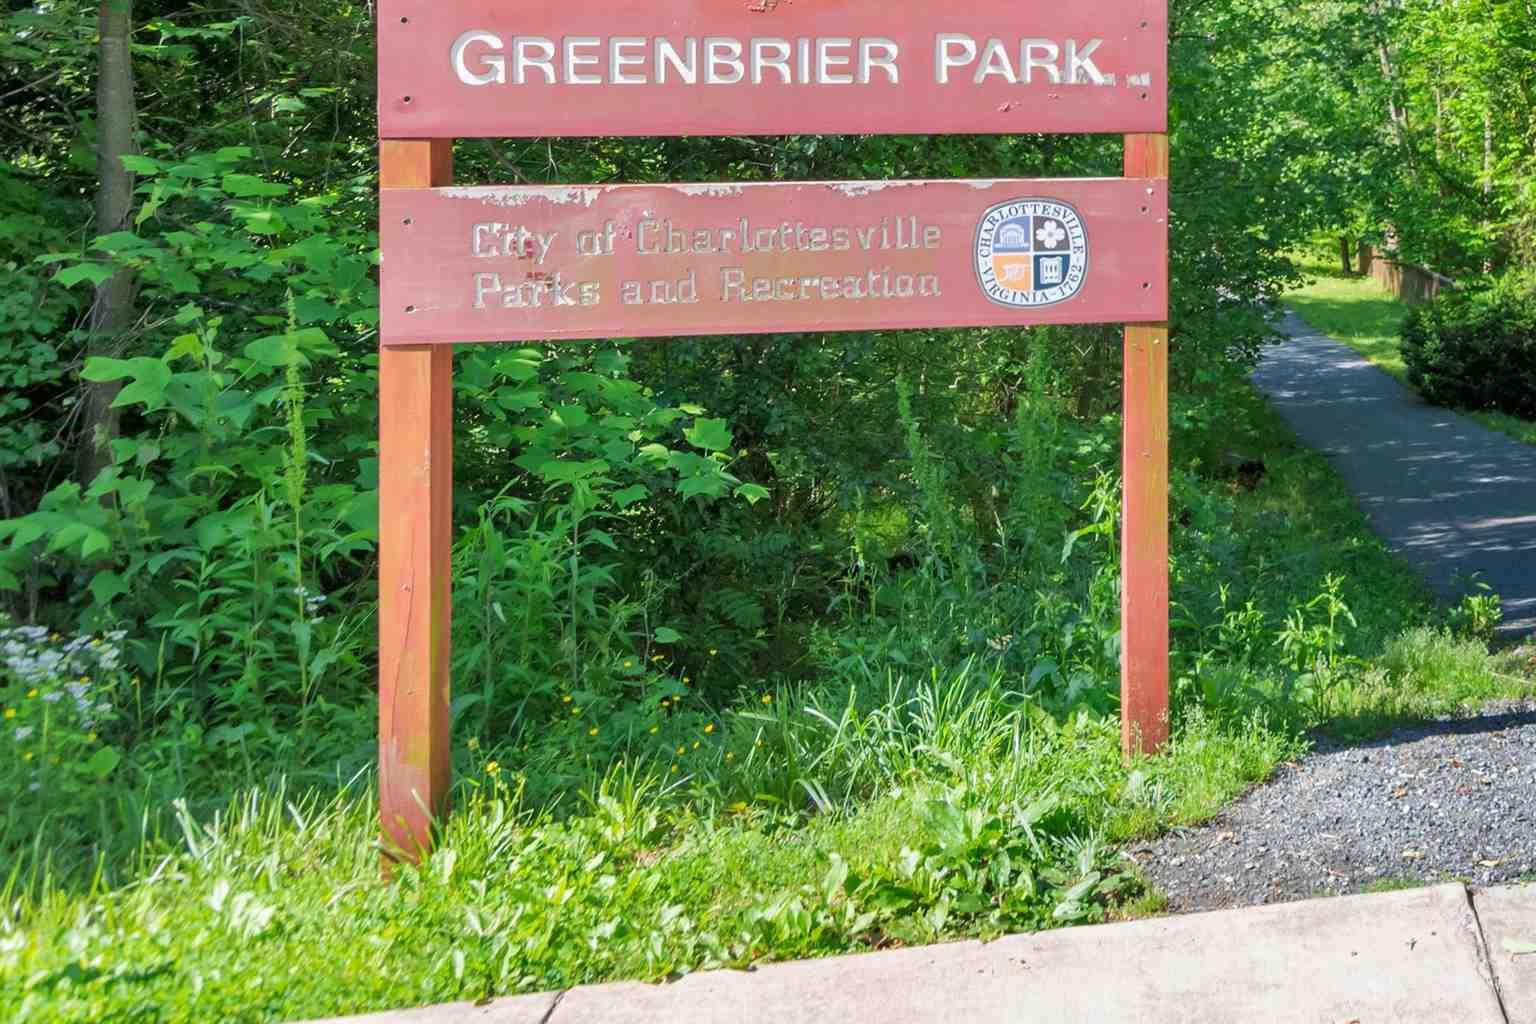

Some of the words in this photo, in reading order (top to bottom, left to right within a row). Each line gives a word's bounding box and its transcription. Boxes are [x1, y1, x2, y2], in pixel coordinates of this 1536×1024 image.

[450, 29, 899, 86] GREENBRIER
[935, 33, 1104, 85] PARK
[472, 223, 556, 264] City
[576, 220, 616, 256] of
[635, 214, 942, 255] Charlottesville
[979, 203, 1084, 258] CHARLOTTESVILLE
[473, 273, 600, 308] Parks
[619, 272, 699, 305] and
[720, 265, 943, 303] Recreation
[981, 266, 1049, 303] VIRGINIA
[1058, 263, 1083, 297] 1762
